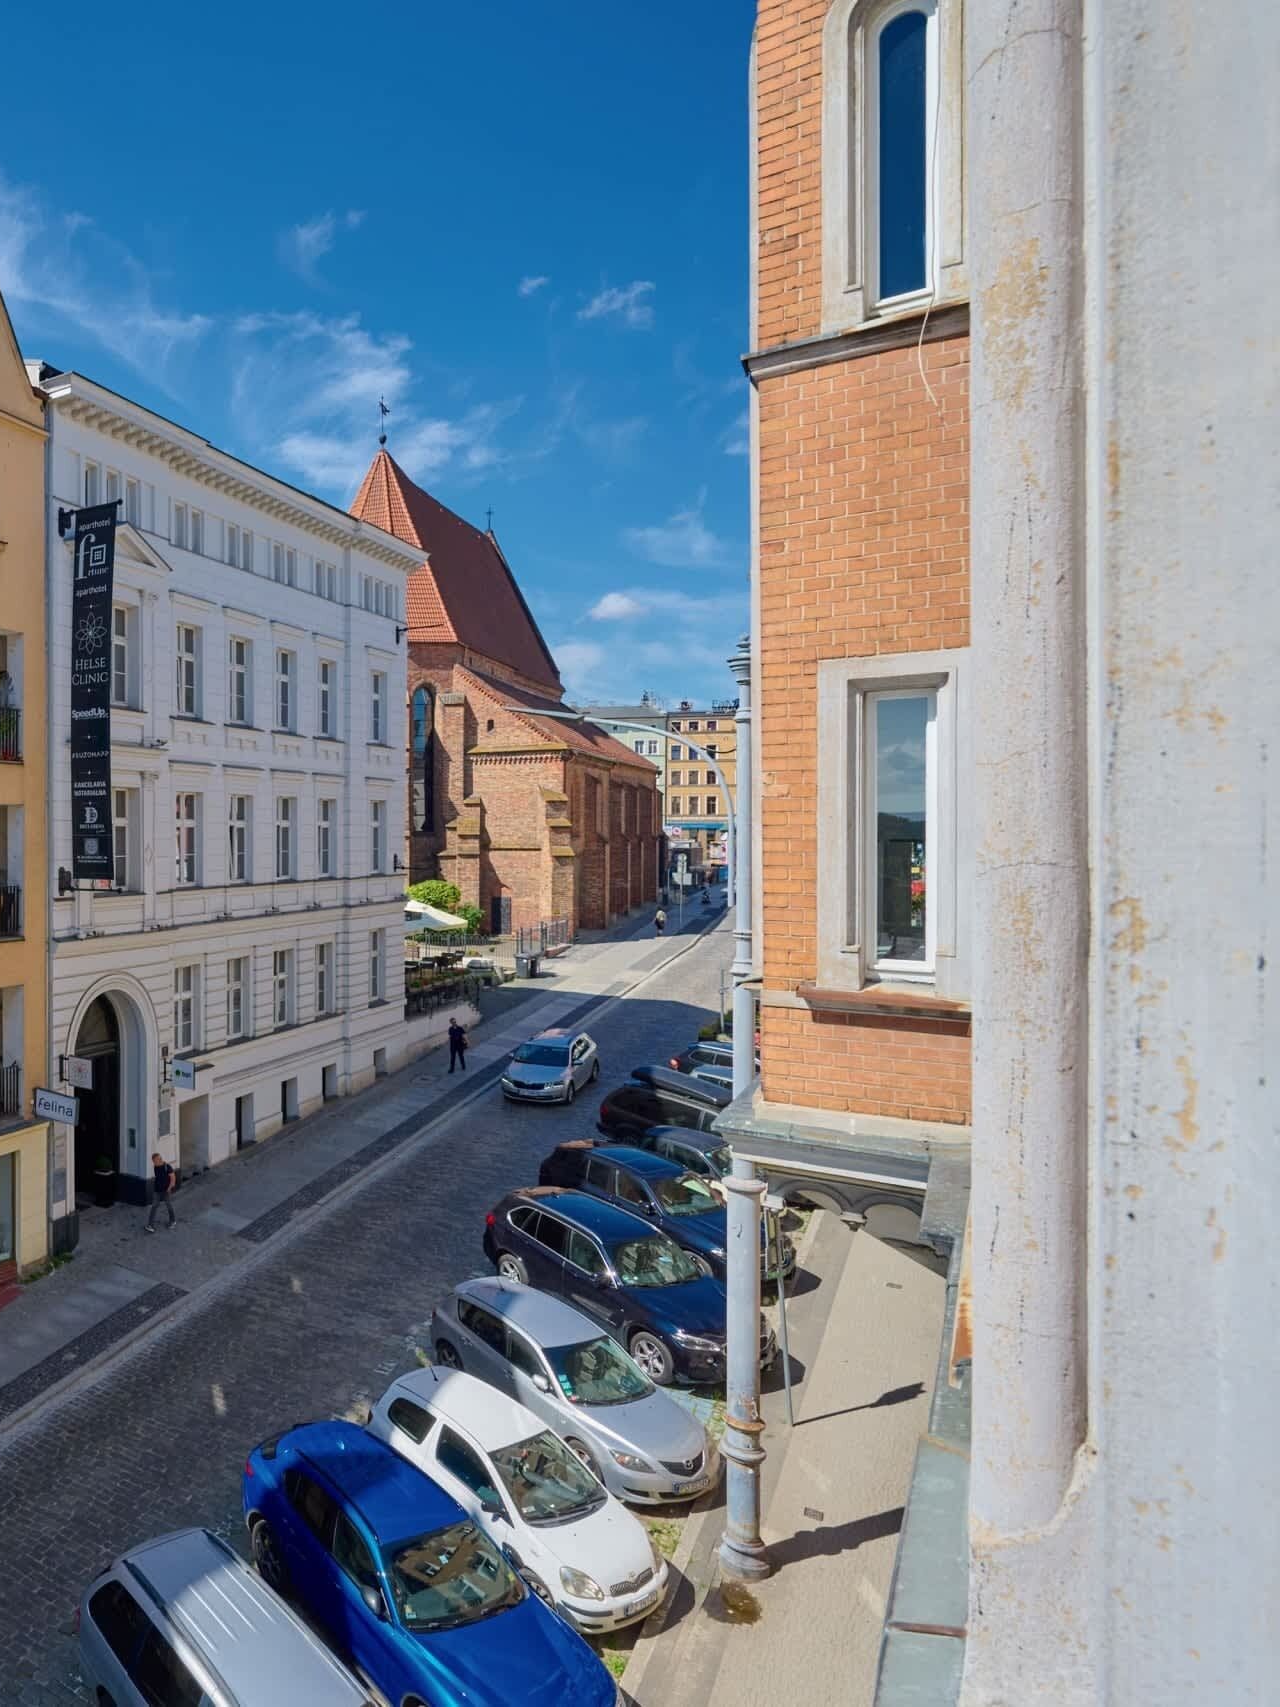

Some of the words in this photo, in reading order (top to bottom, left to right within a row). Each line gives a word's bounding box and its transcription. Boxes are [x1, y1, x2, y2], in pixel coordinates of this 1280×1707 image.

[76, 584, 107, 598] aparthotel
[75, 657, 106, 671] HELSE
[72, 671, 109, 686] CLINIC
[38, 1097, 73, 1117] Felina
